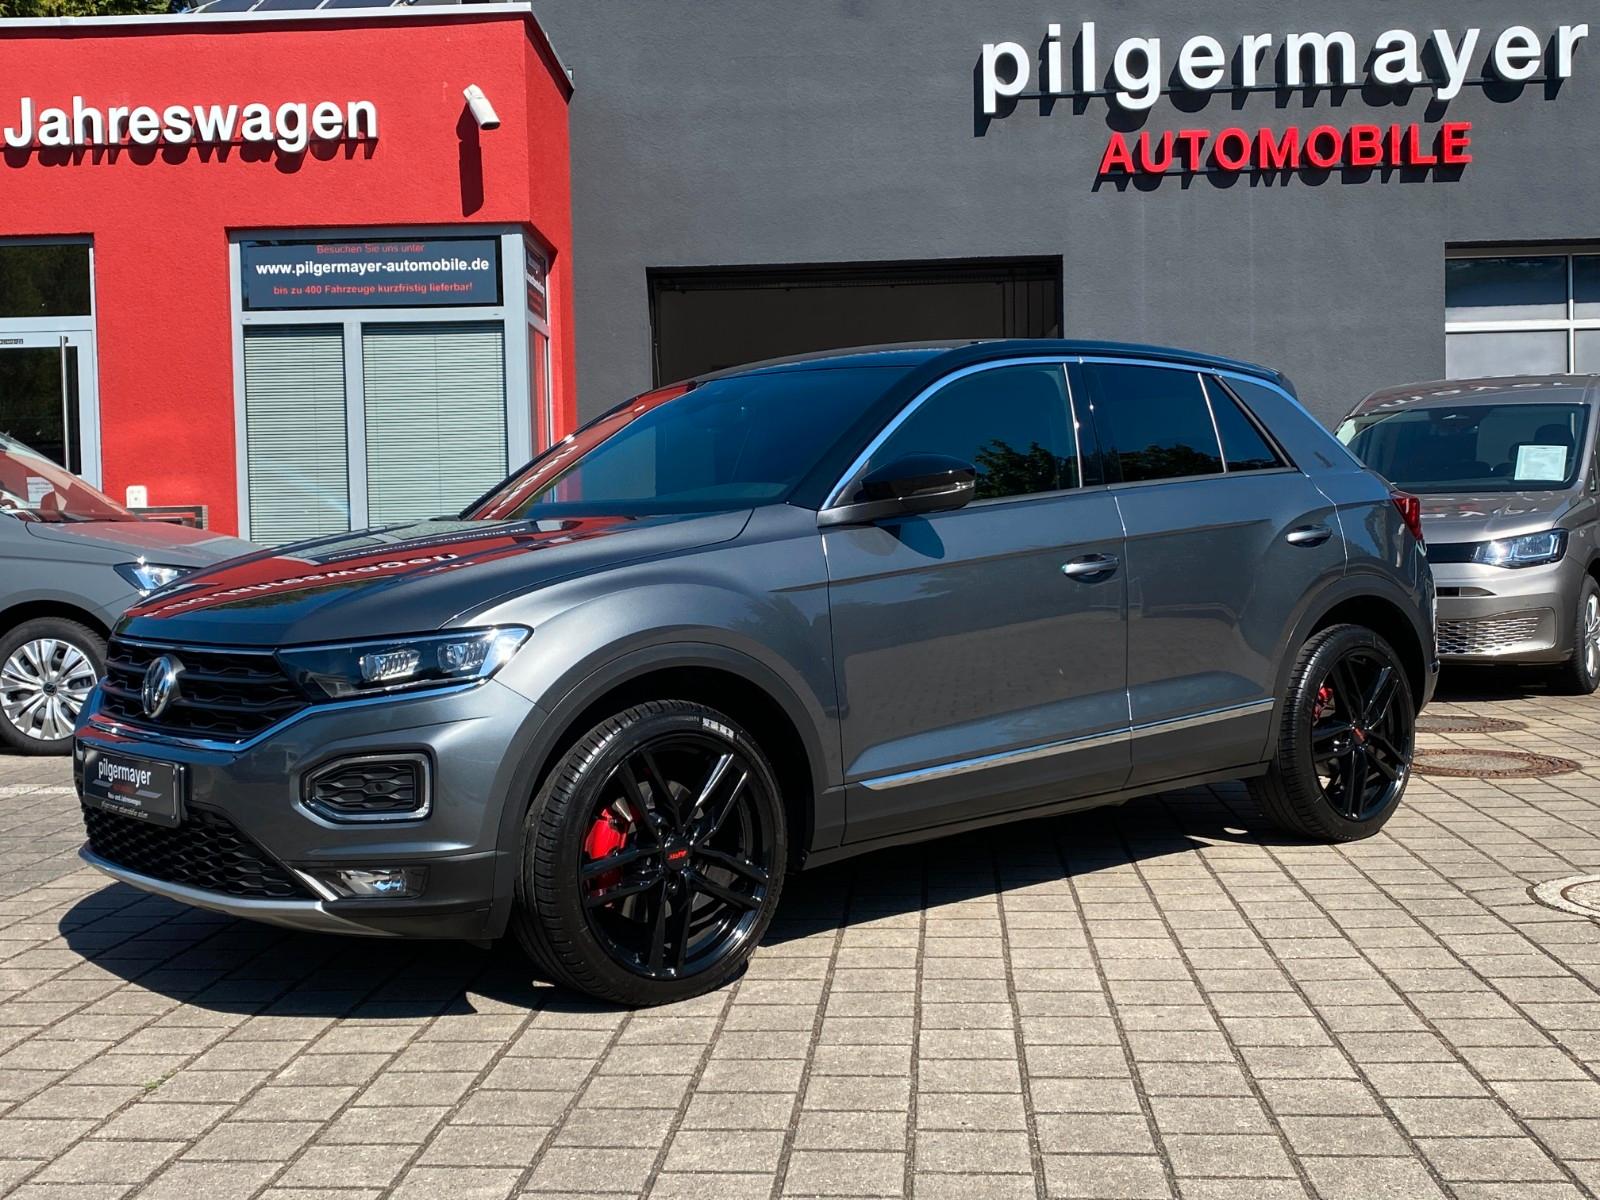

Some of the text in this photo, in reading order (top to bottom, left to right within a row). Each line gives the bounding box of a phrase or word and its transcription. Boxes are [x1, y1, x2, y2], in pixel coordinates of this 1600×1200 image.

[982, 22, 1588, 114] pilgermayer
[3, 95, 378, 153] Jahreswagen
[1100, 122, 1473, 174] AUTOMOBILE
[316, 242, 424, 254] Besuchen Sie uns unter
[256, 258, 489, 277] www.pilgermayer-automobile.de
[273, 282, 473, 295] bis zu 400 Fahrzeuge kurzfristig lieferbar!
[98, 758, 152, 788] pilgermayer
